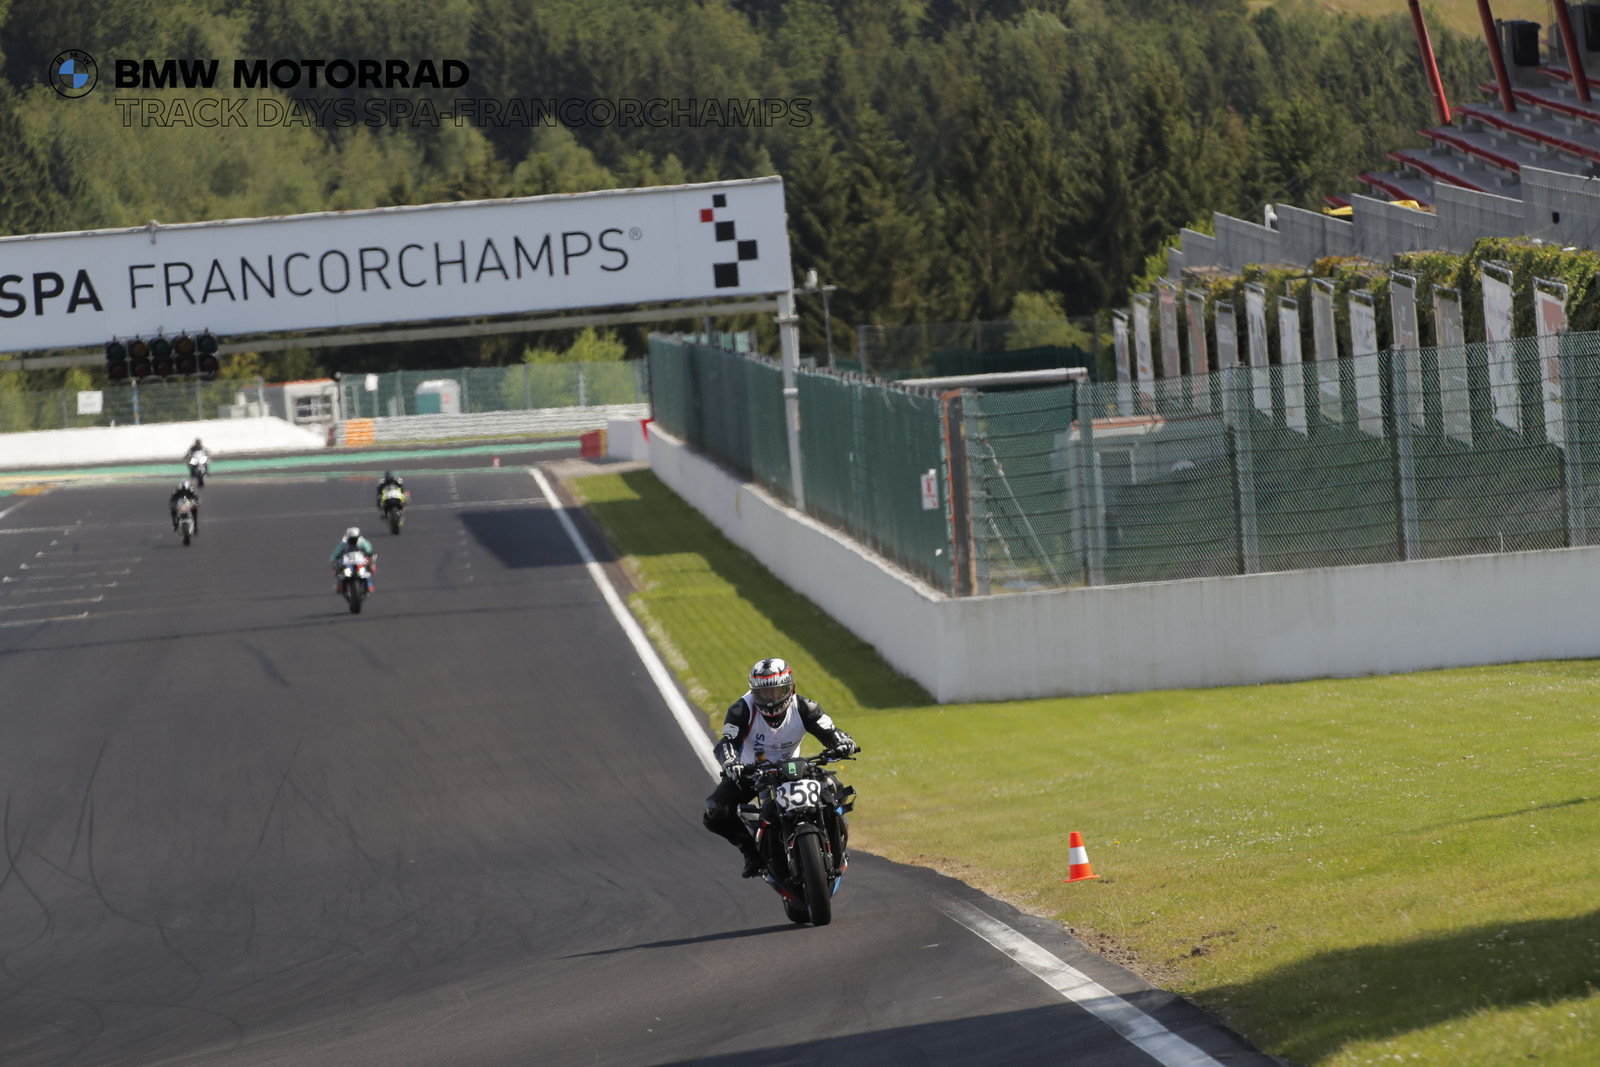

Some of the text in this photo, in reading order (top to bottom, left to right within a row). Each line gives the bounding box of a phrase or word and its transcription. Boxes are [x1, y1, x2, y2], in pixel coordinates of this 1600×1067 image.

[0, 227, 629, 319] SPA FRANCORCHAMPS
[778, 781, 819, 809] 358
